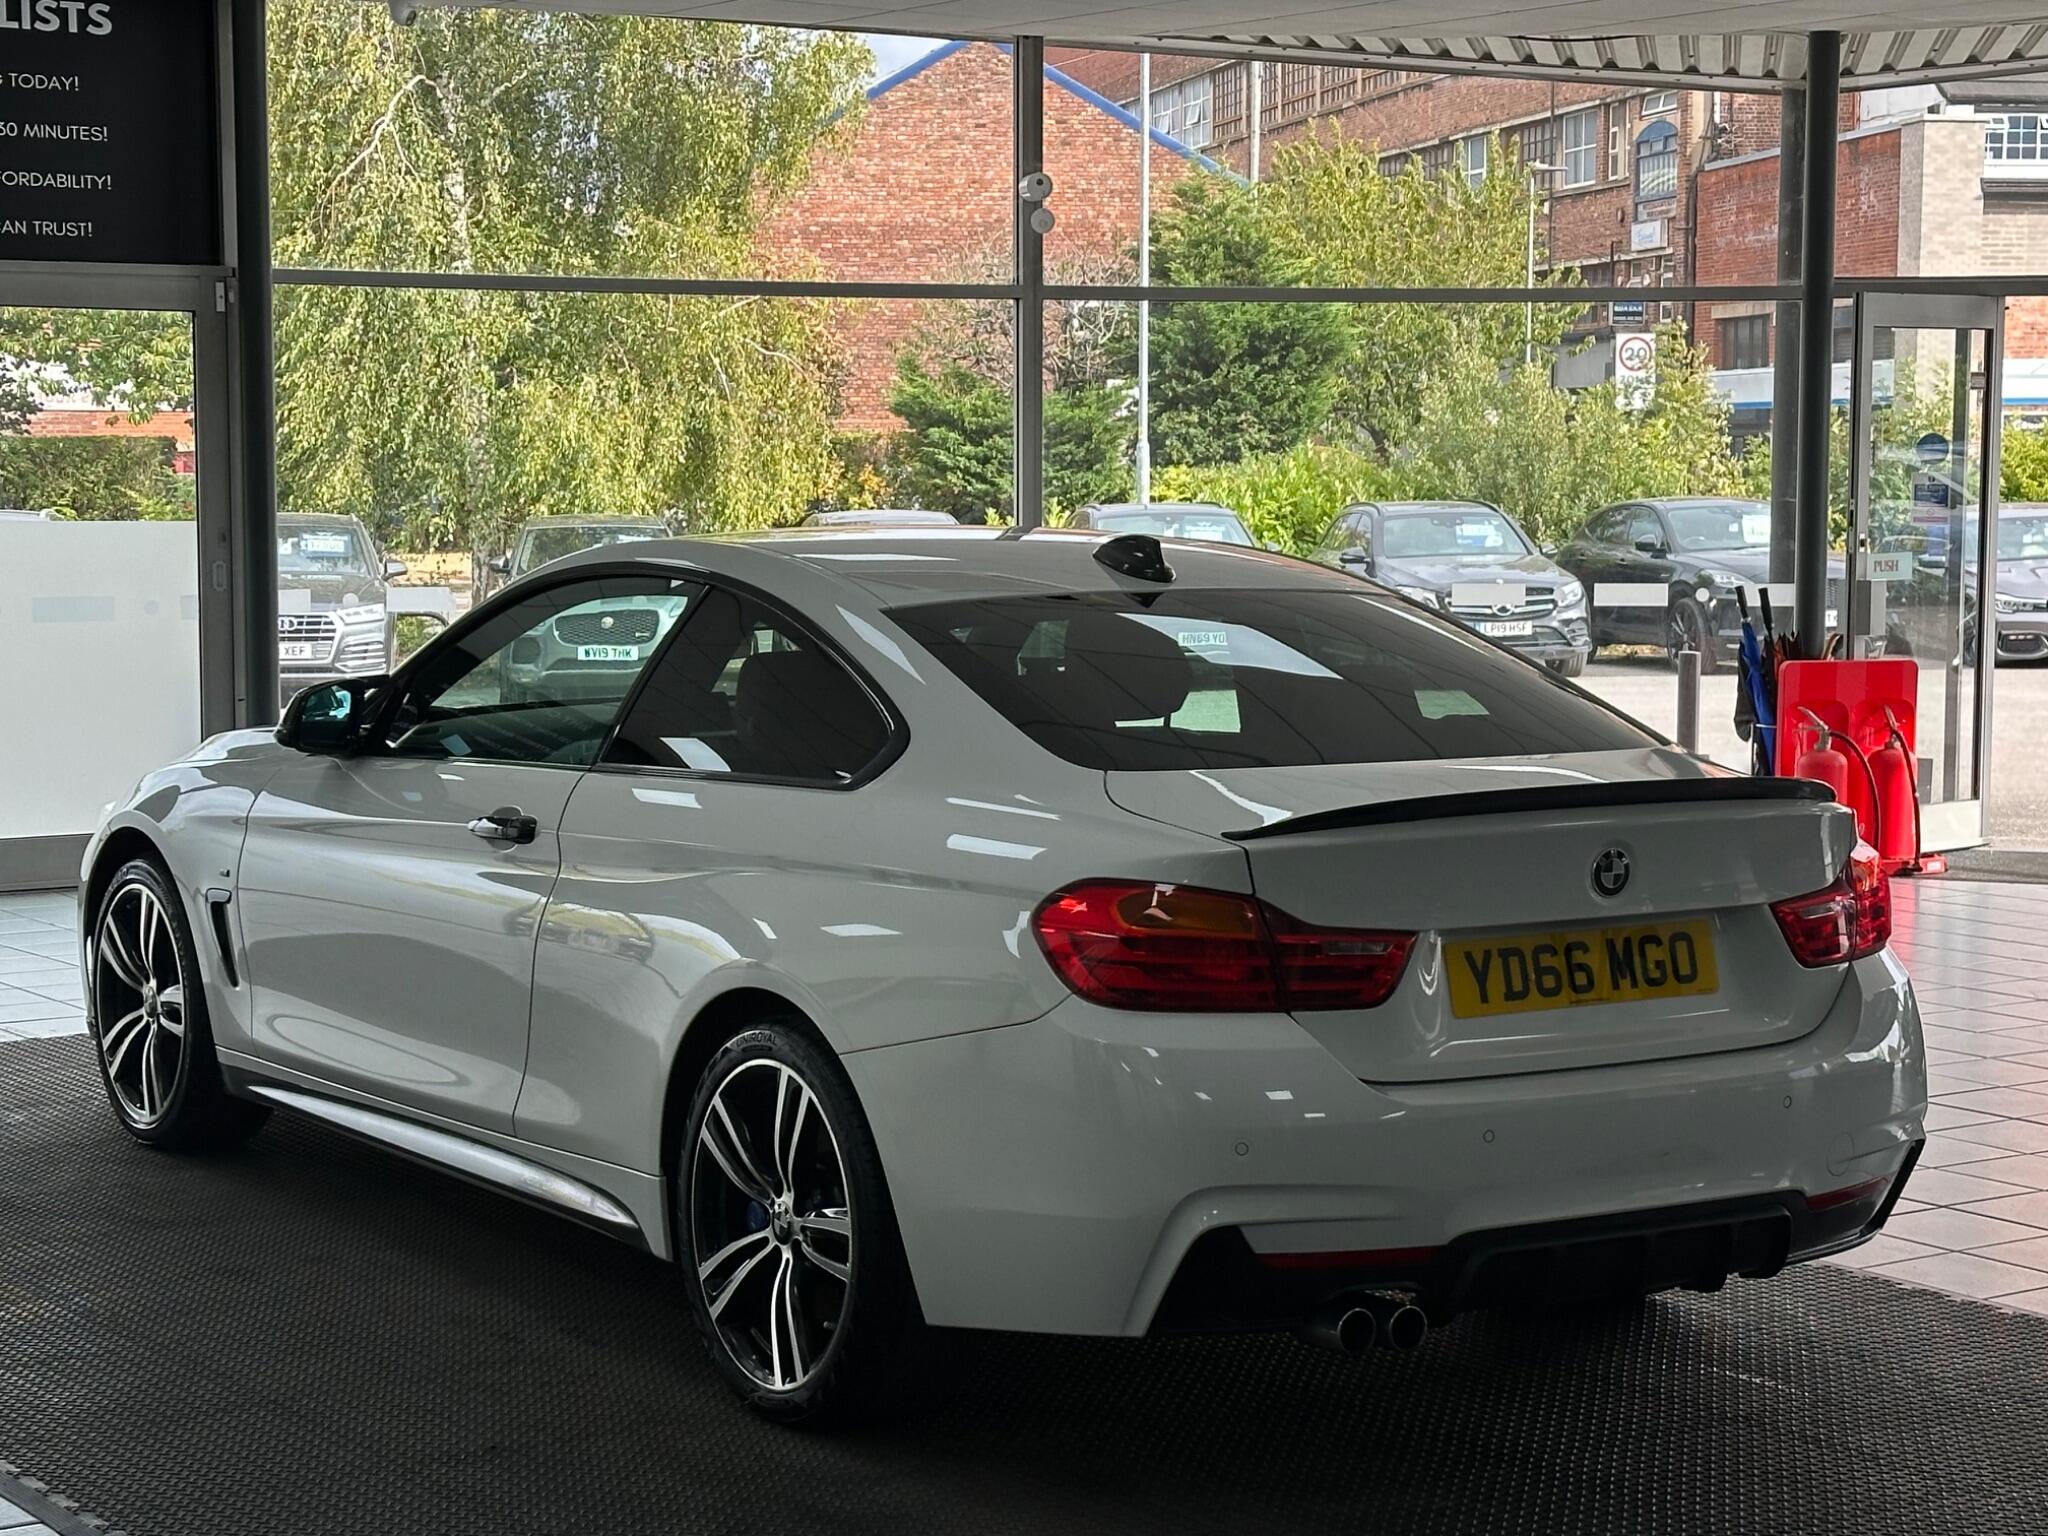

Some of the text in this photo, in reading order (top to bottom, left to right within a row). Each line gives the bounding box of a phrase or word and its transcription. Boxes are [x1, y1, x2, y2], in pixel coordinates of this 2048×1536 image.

[8, 73, 79, 91] TODAY!
[24, 124, 108, 142] MINUTES!
[0, 171, 112, 190] ORDABILITY!
[0, 220, 92, 237] AN TRUST!
[1624, 347, 1648, 361] 20
[1873, 560, 1899, 572] PUSH
[1464, 931, 1698, 1004] YD66 MGO
